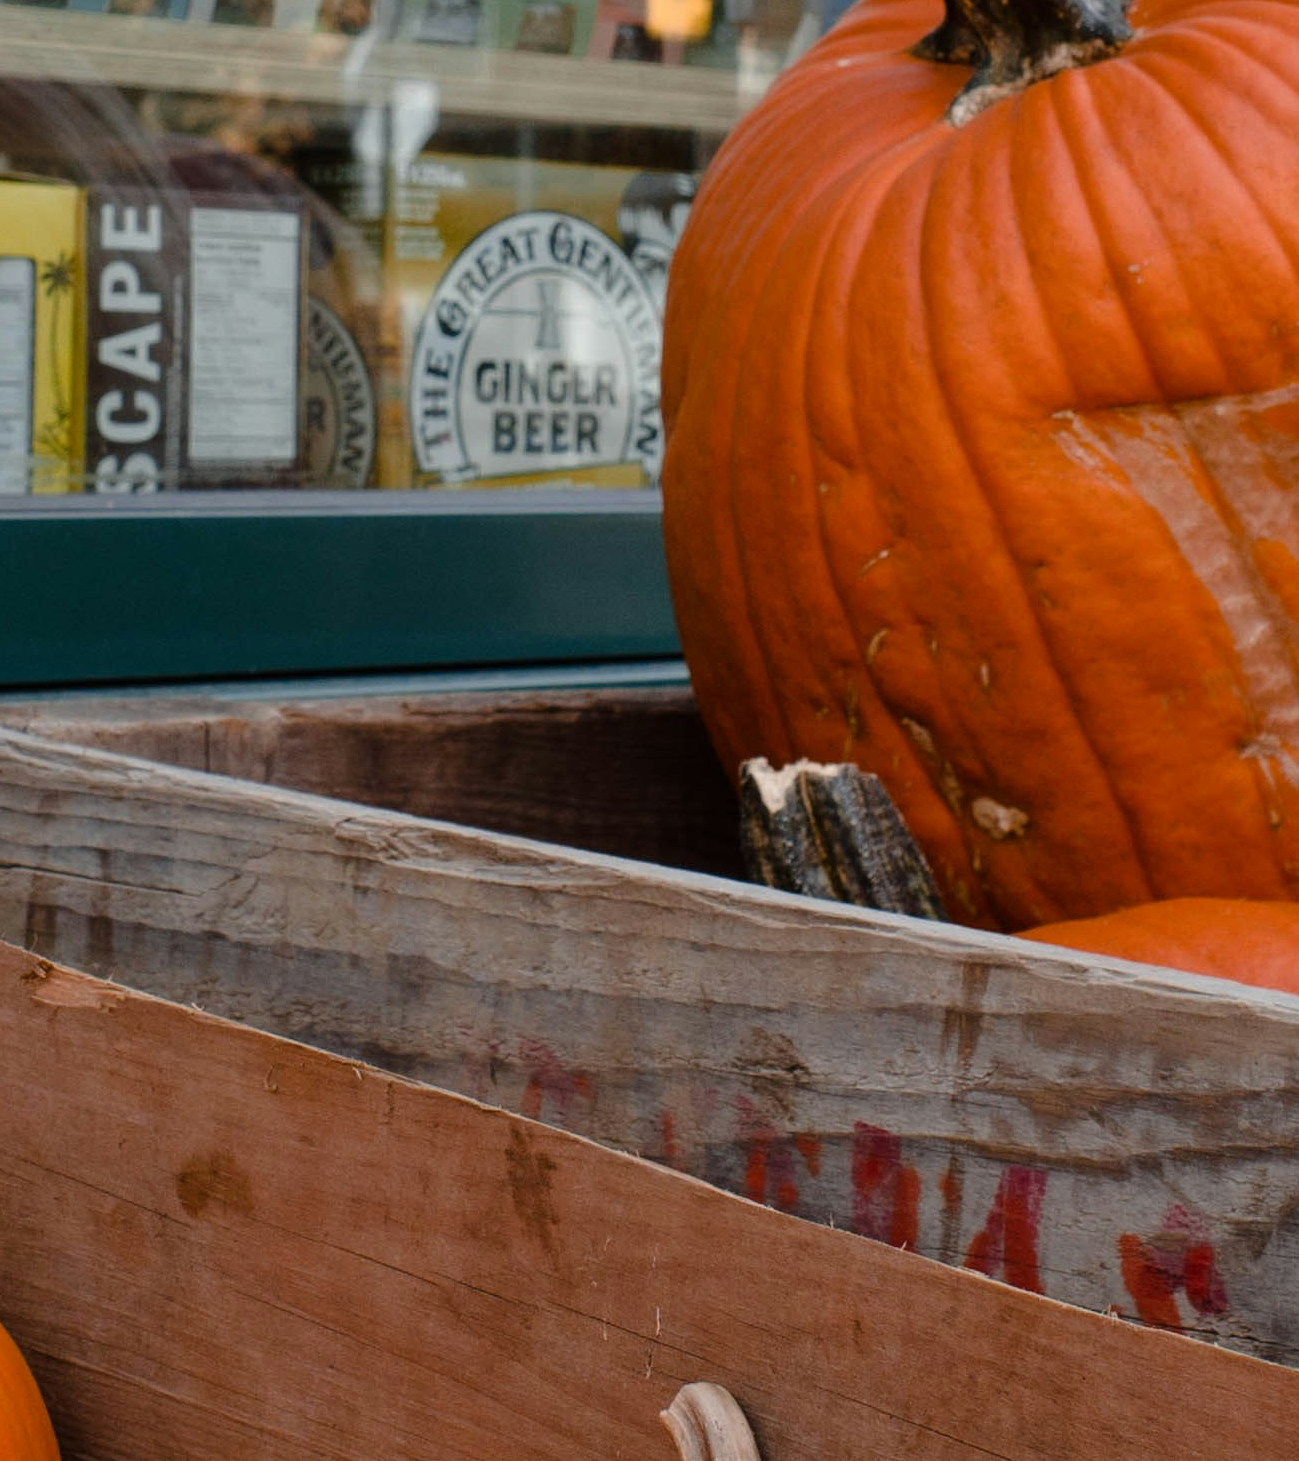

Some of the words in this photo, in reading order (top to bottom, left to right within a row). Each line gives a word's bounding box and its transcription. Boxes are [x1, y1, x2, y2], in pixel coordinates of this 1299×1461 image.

[434, 226, 540, 341] GREAT
[419, 347, 455, 463] THE
[473, 359, 617, 407] GINGER
[492, 411, 601, 455] BEER
